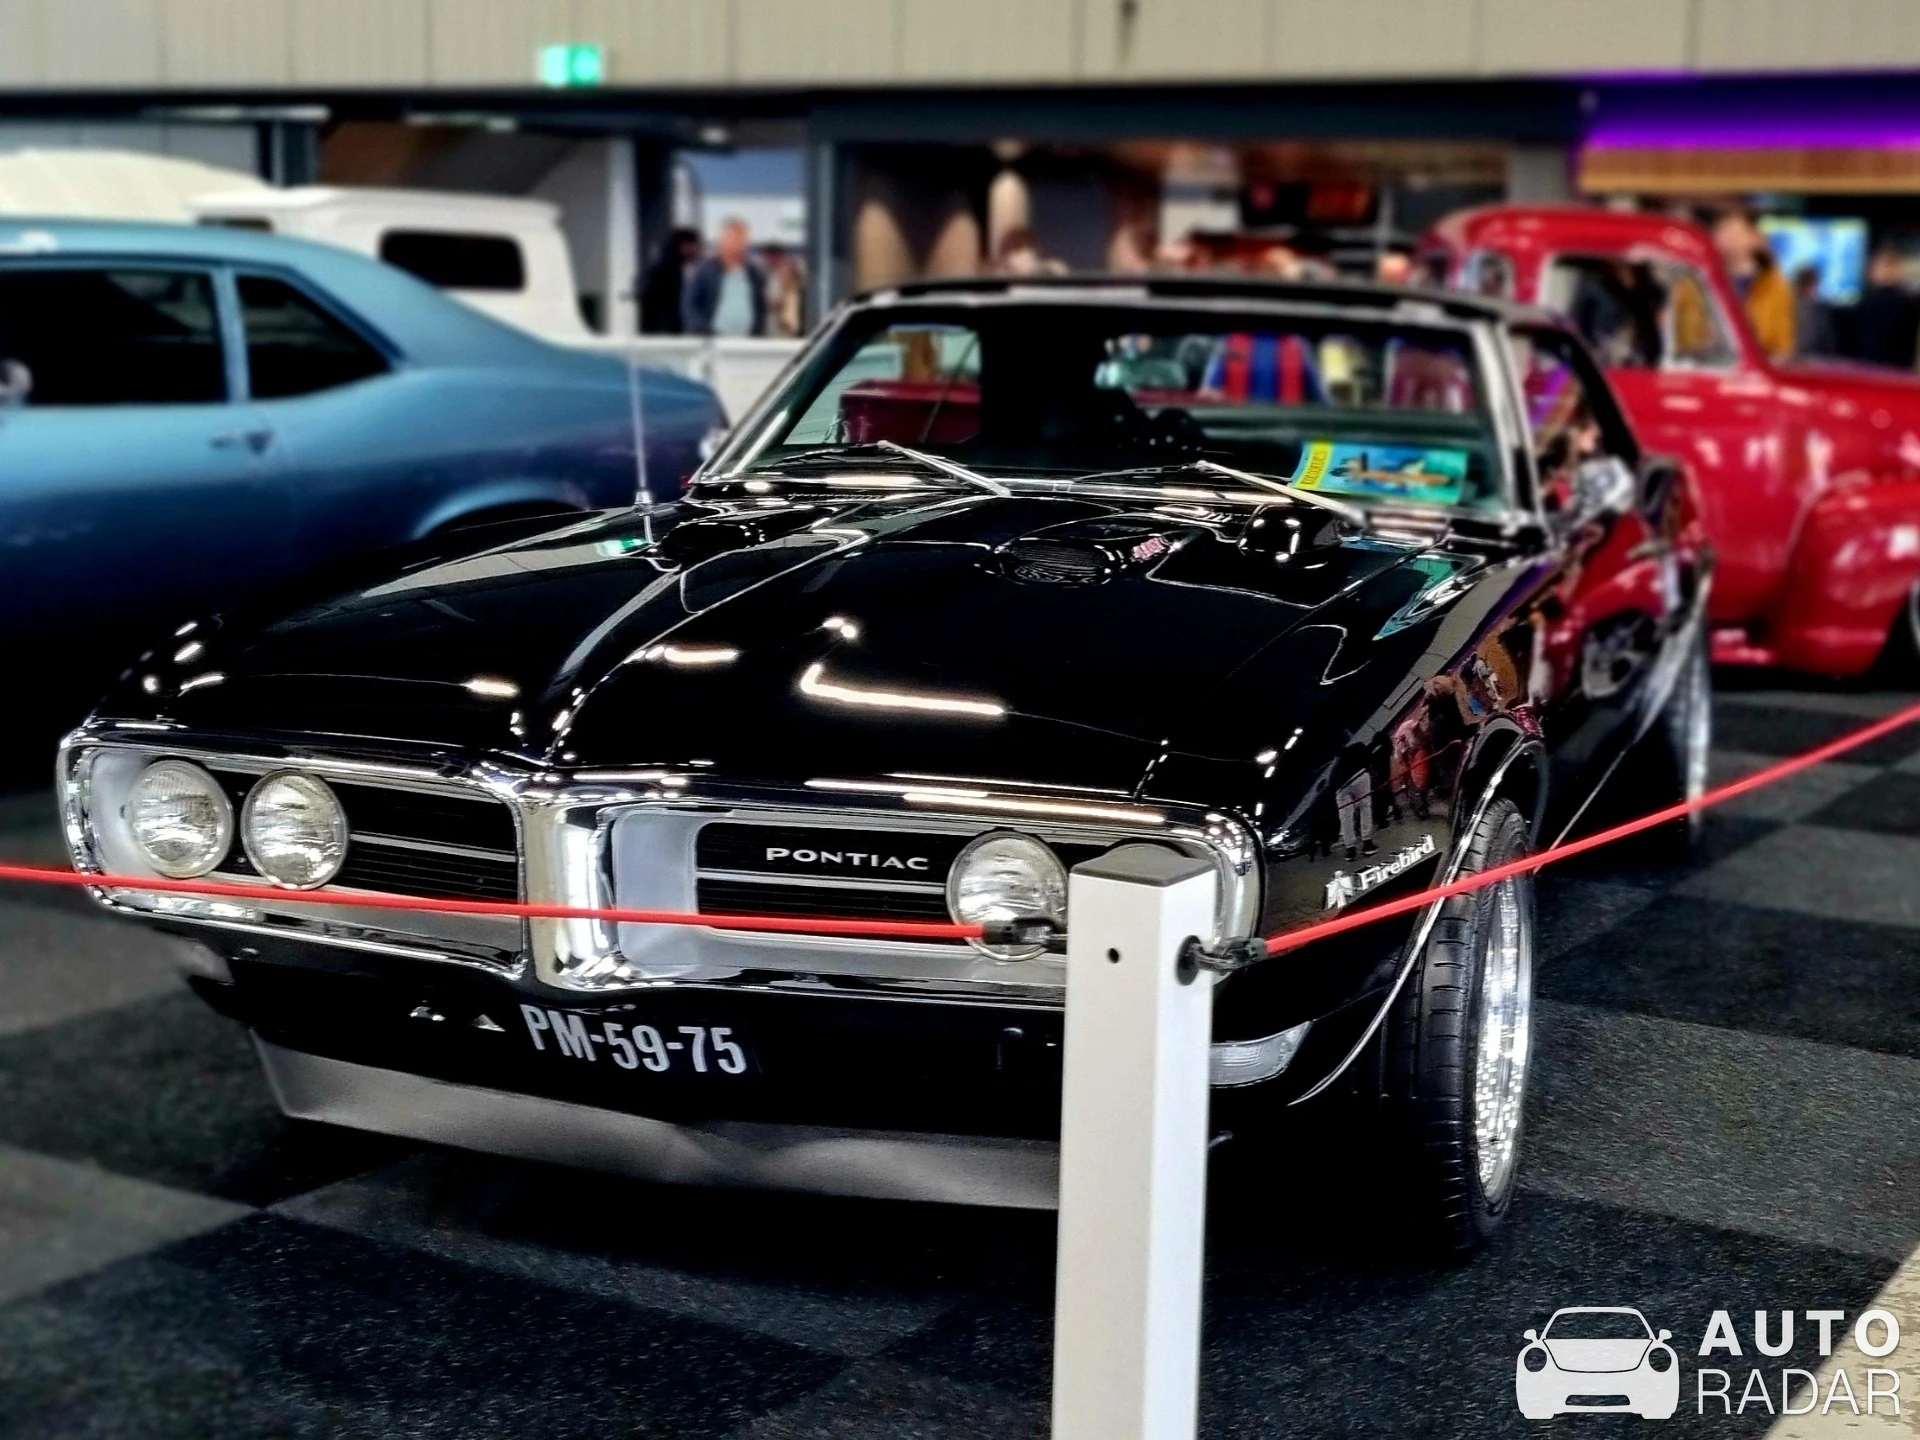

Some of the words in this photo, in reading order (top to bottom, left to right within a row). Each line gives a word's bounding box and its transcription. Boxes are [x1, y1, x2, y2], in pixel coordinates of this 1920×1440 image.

[765, 847, 930, 871] PONTIAC
[1358, 834, 1436, 891] Firebird
[519, 1003, 748, 1075] PM-59-75
